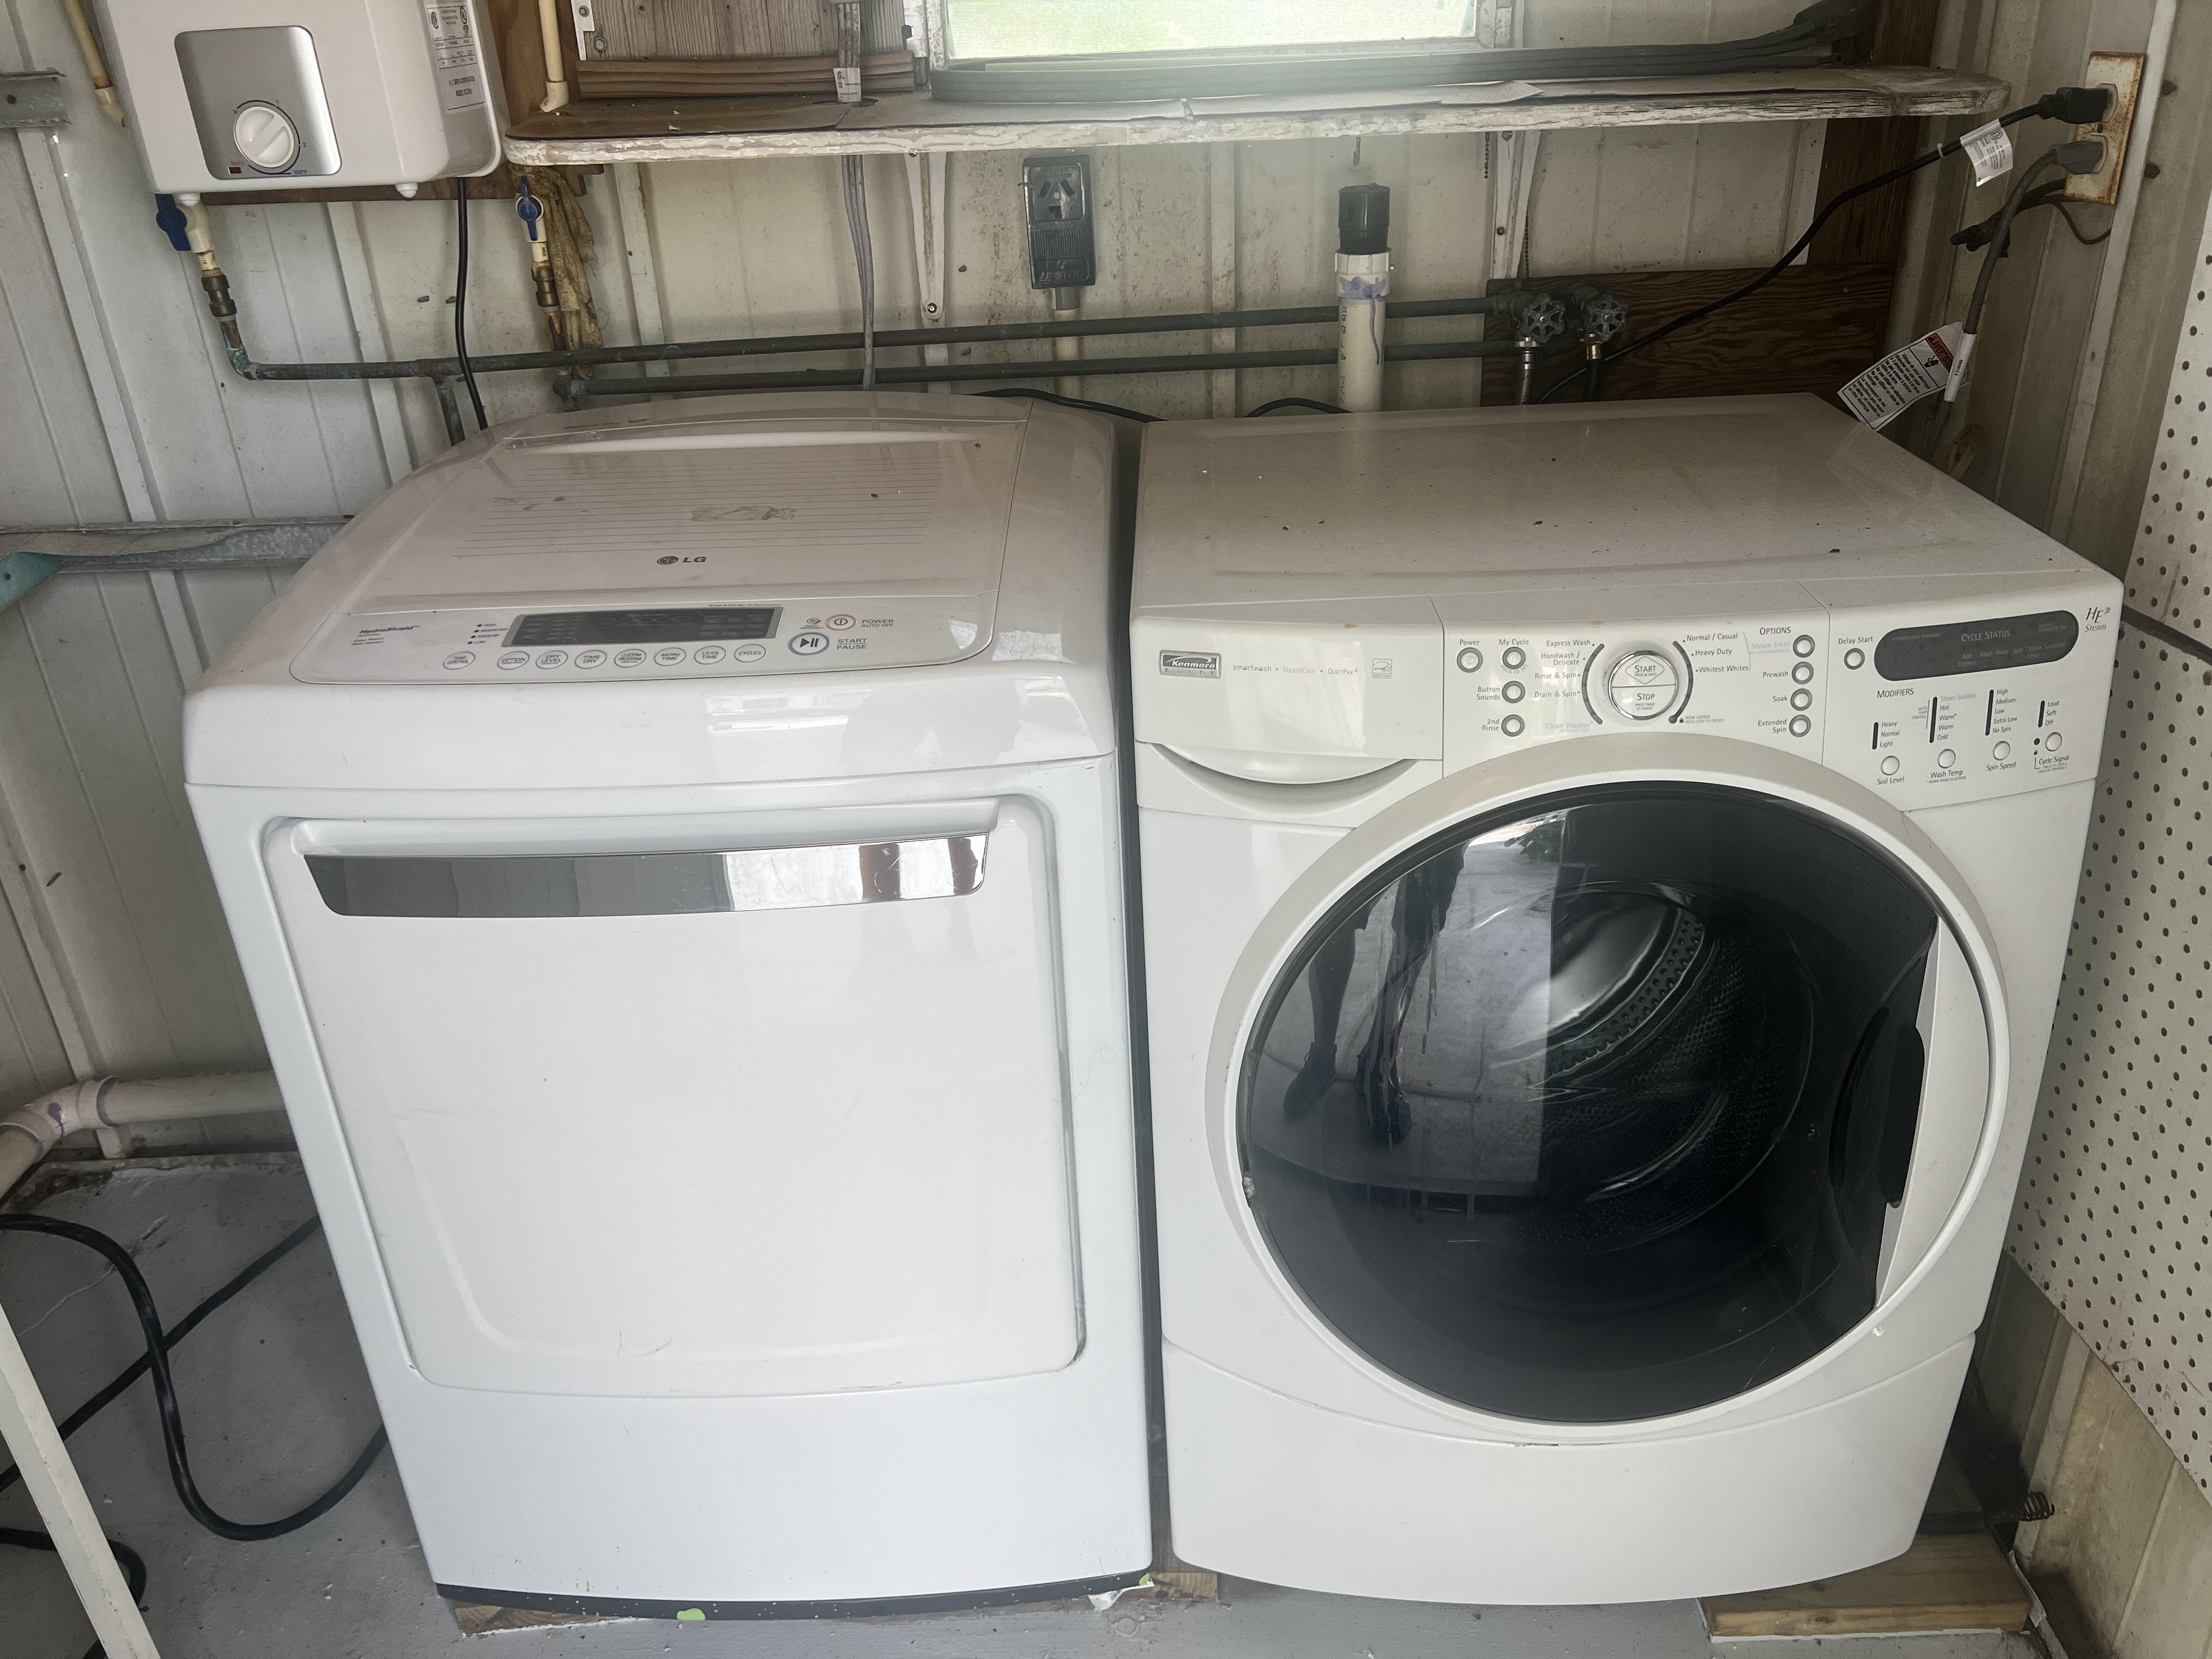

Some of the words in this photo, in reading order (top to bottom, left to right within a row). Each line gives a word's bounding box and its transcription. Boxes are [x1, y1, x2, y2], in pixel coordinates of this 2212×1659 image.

[1759, 627, 1791, 635] OPTIONS
[2085, 624, 2107, 633] Steam
[1961, 633, 1983, 642] CYCLE
[1984, 630, 2011, 640] STATUS
[1172, 660, 1216, 669] Kenmore
[1233, 664, 1272, 672] smartwash
[1877, 688, 1914, 698] MODIFIERS
[1758, 718, 1787, 726] Extended
[1773, 726, 1787, 735] Spin
[2000, 761, 2016, 771] Speed
